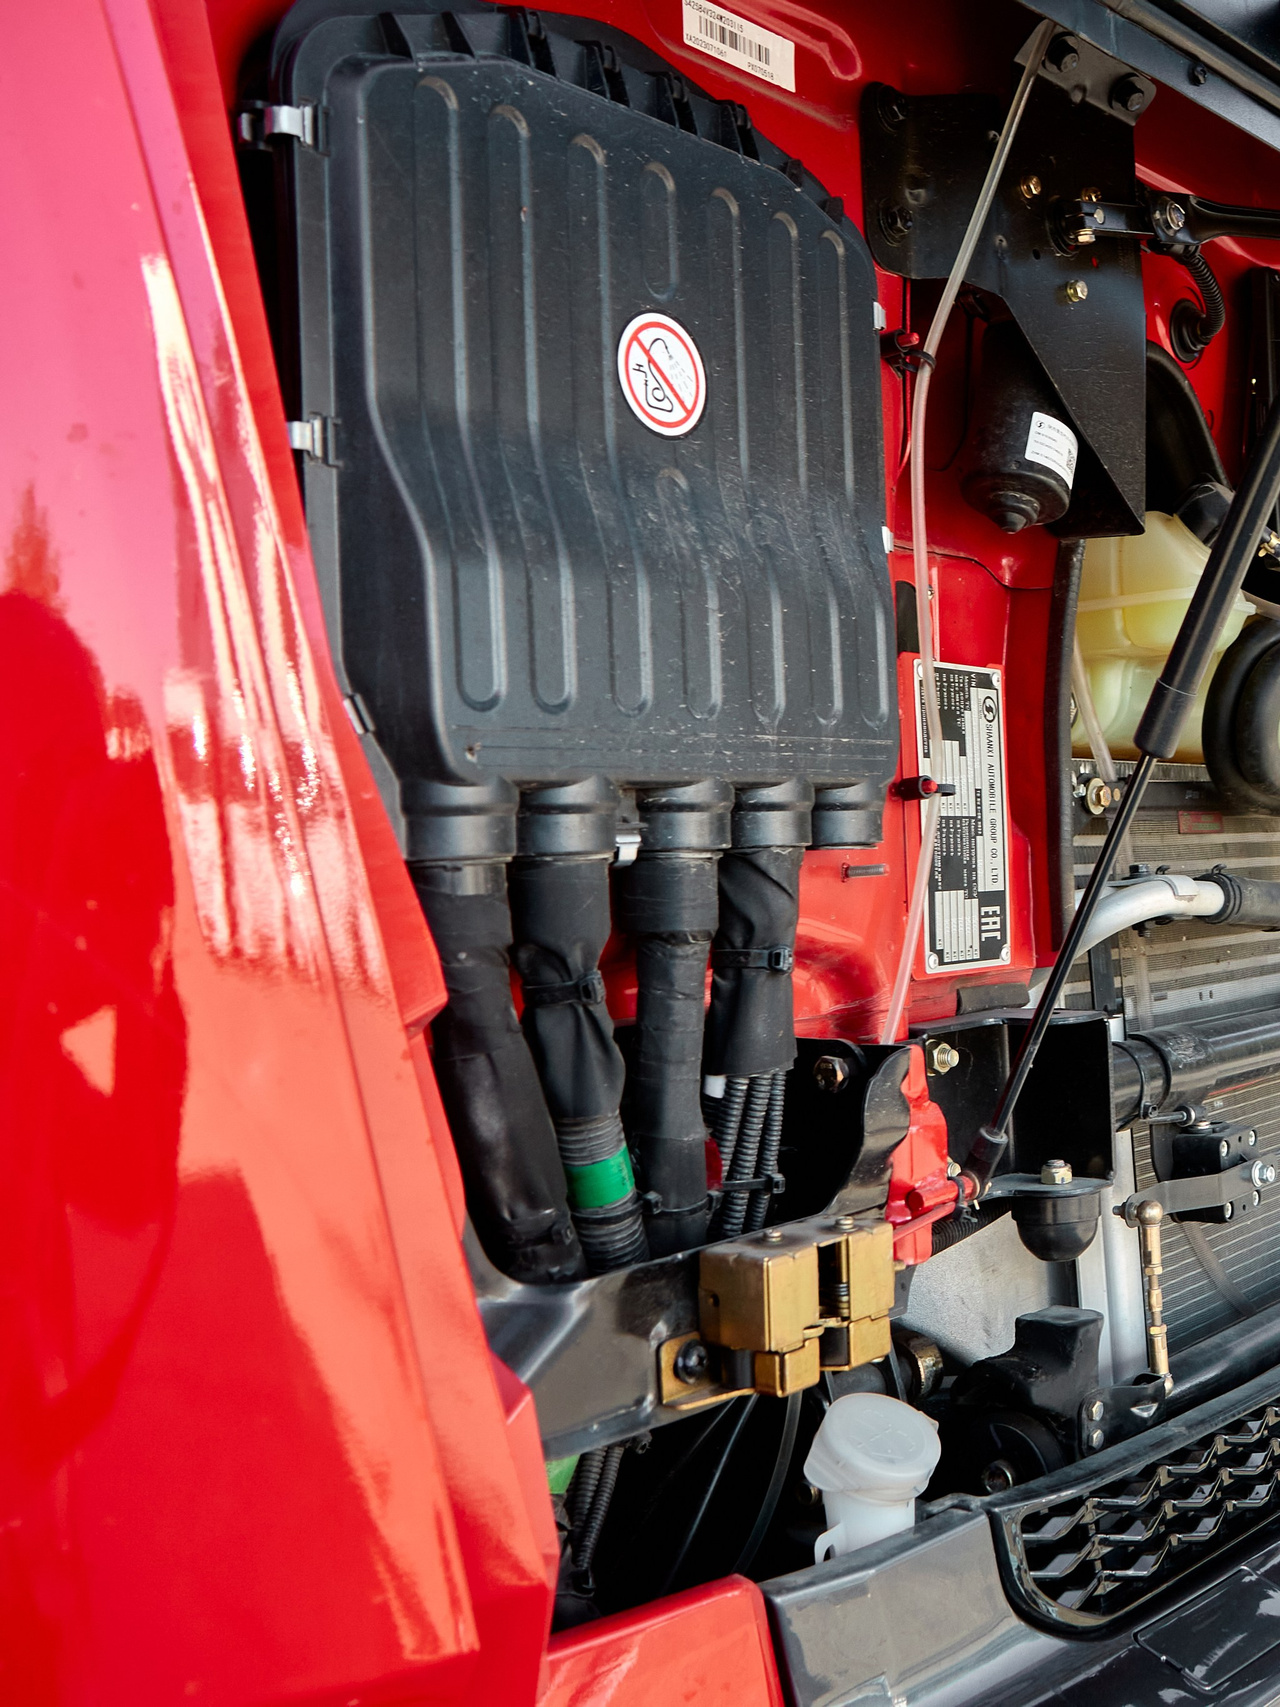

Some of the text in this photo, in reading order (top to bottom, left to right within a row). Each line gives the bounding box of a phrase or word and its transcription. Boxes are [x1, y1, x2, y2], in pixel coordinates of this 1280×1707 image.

[985, 723, 994, 758] SHAANXI
[987, 763, 996, 814] AUTOMOBILE
[989, 818, 997, 844] GROUP
